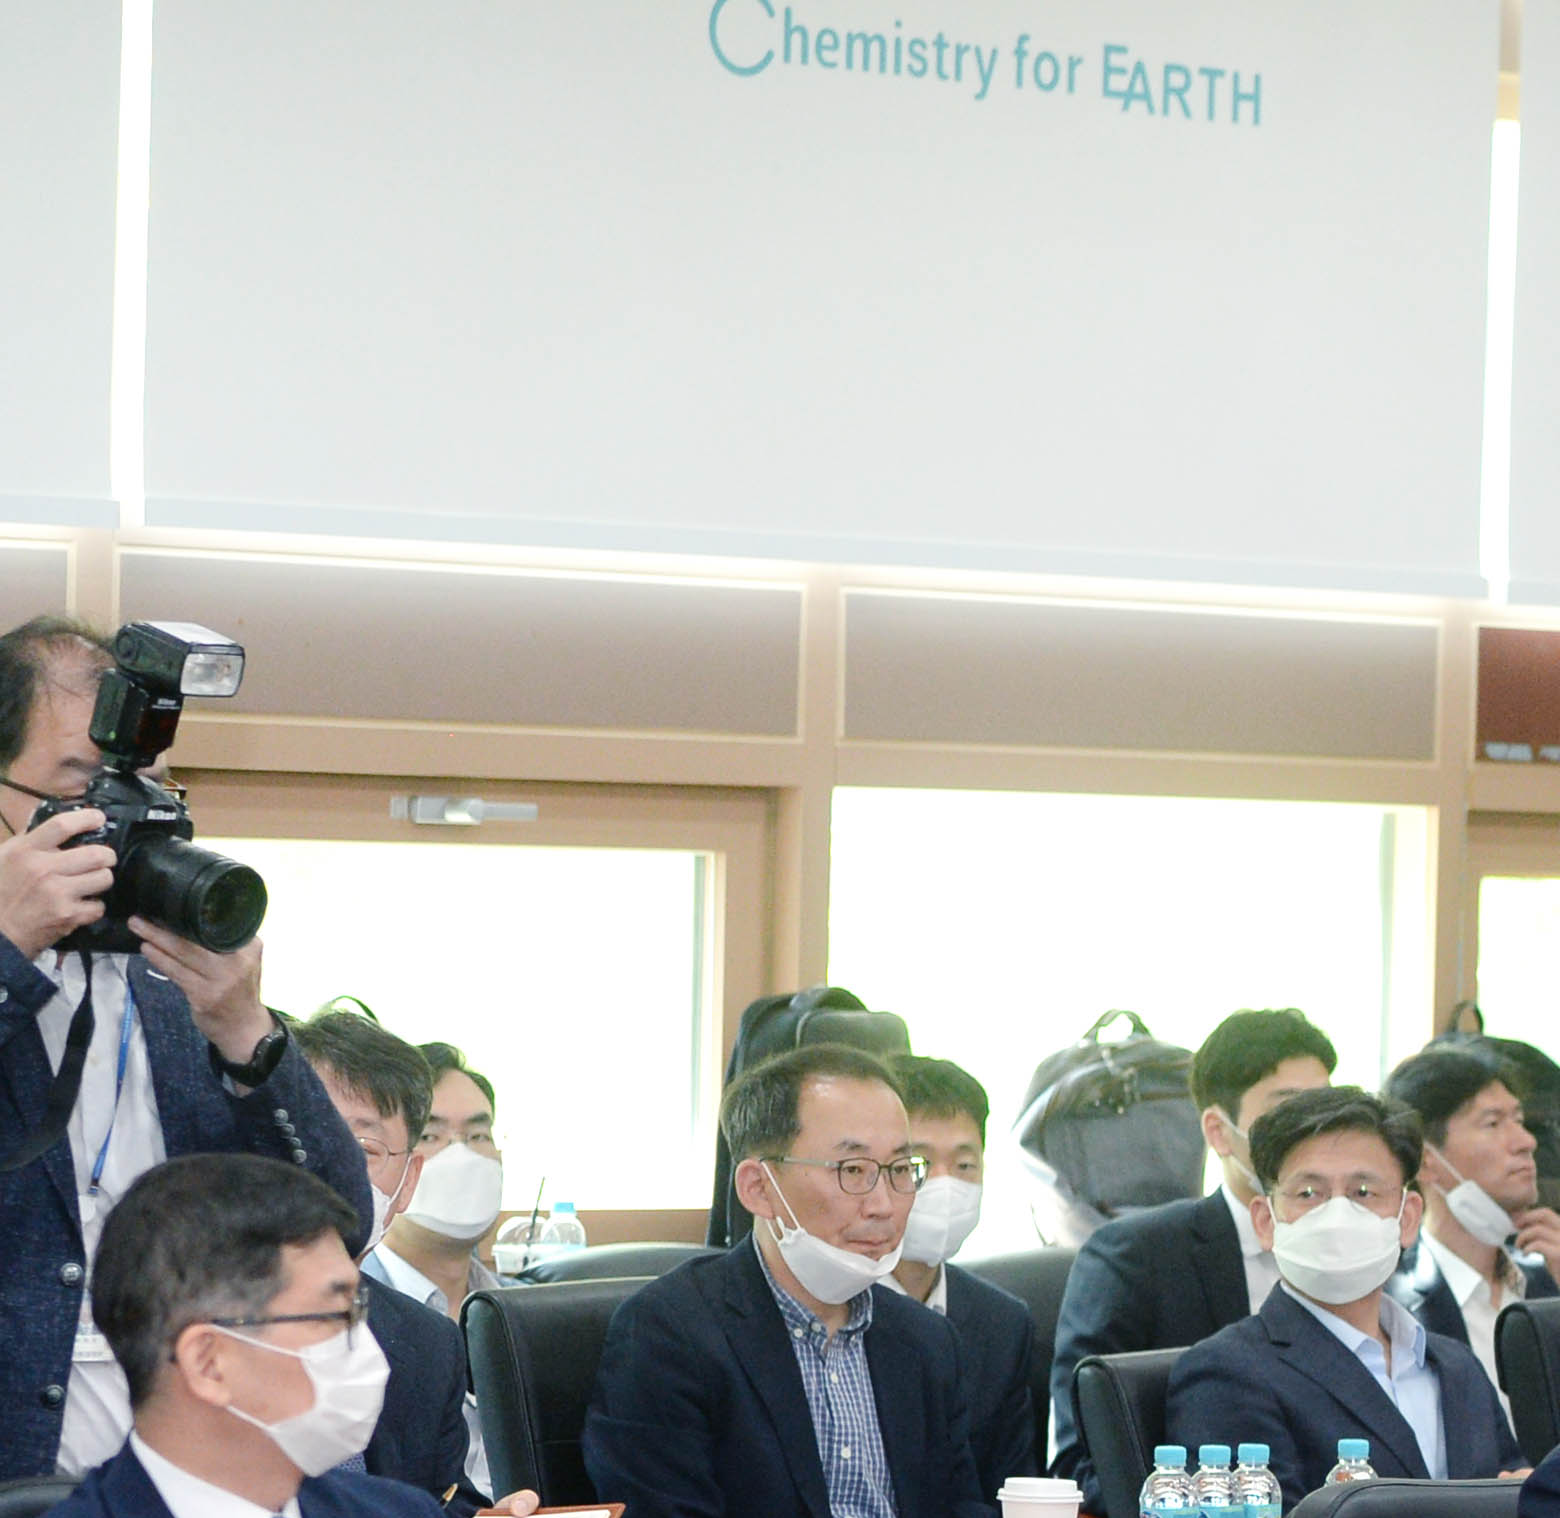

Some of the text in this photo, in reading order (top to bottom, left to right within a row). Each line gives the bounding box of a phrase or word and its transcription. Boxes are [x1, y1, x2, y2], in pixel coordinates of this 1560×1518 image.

[708, 0, 1262, 126] Chemistry for EARTH
